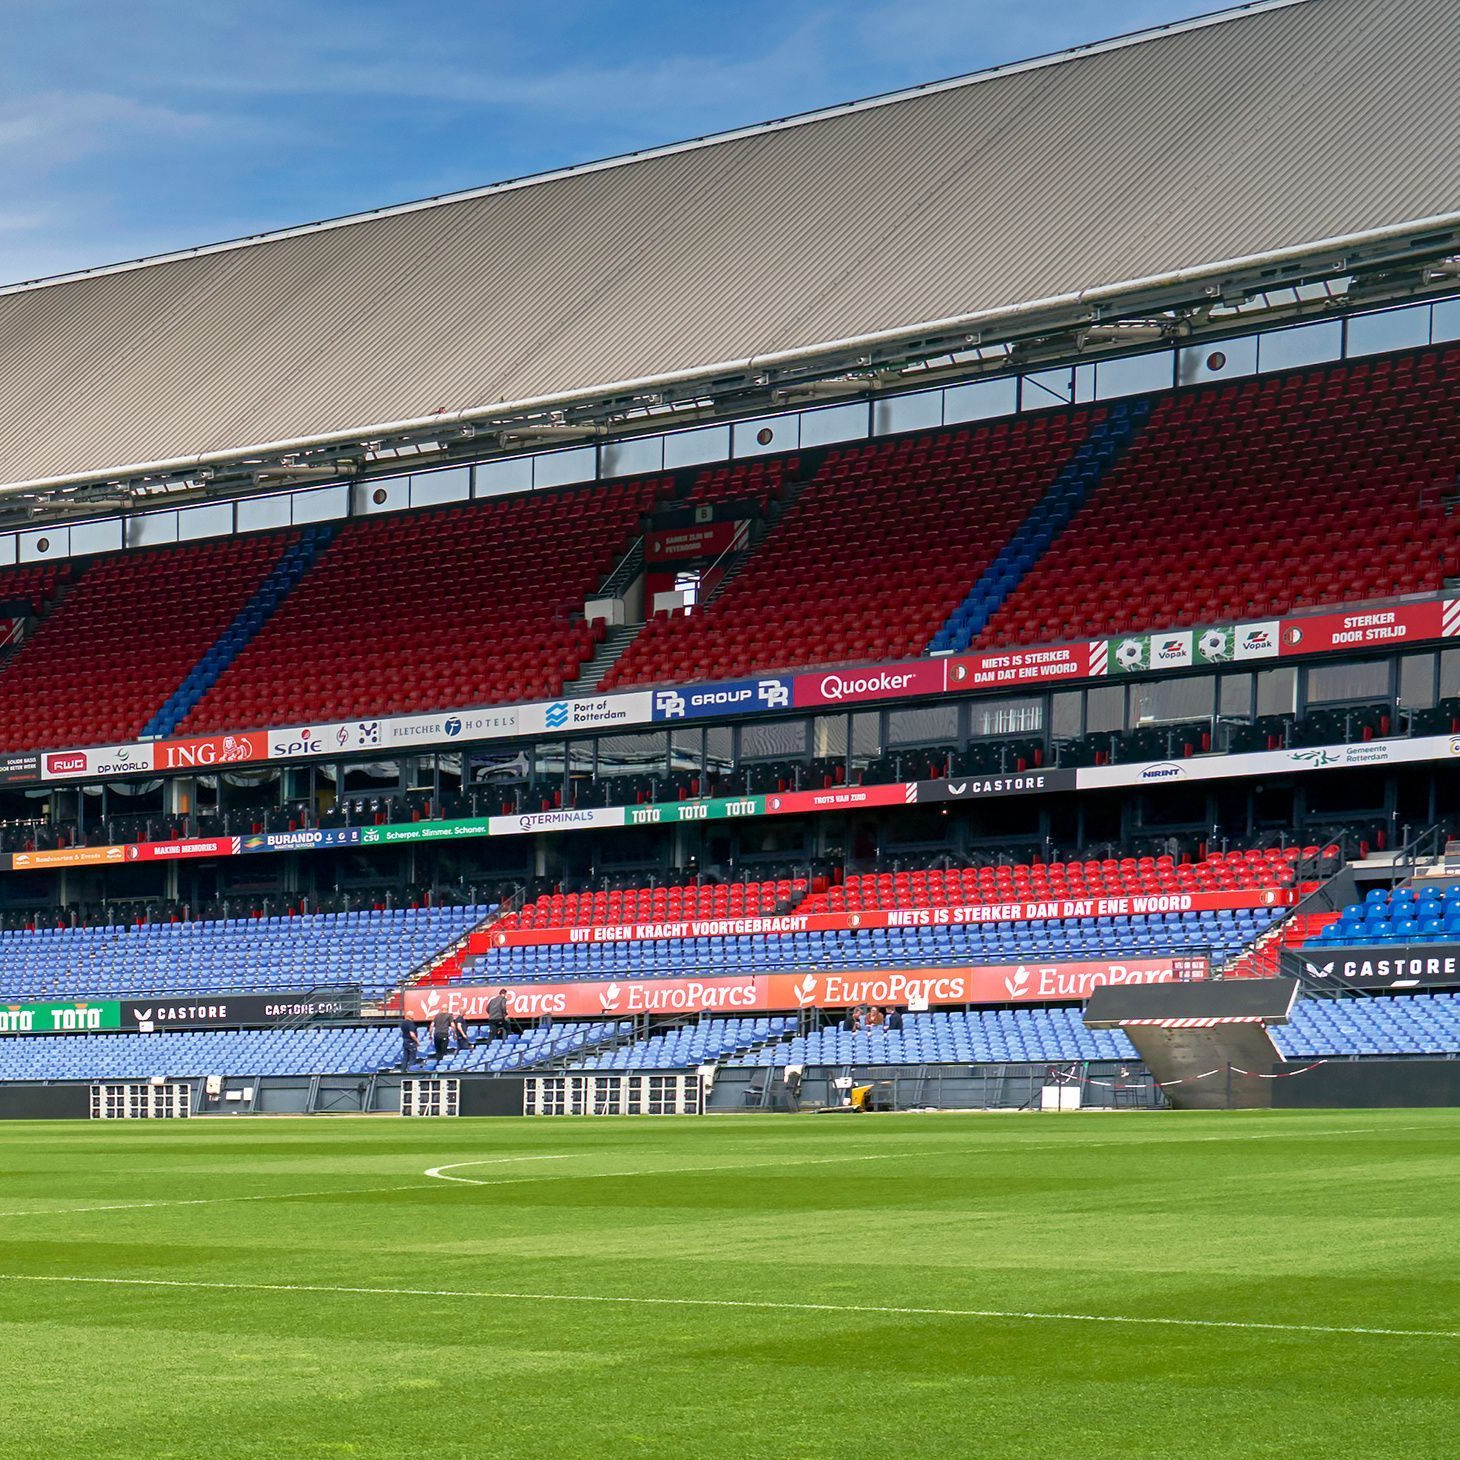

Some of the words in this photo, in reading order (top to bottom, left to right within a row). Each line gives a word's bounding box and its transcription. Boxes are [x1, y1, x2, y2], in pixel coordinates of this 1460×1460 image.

[1344, 612, 1396, 628] STERKER
[1332, 631, 1363, 644] DOOR
[1366, 625, 1407, 640] STRIJD
[1243, 640, 1272, 650] Vopak
[982, 658, 1010, 669] NIETS
[1012, 656, 1023, 665] IS
[1025, 650, 1070, 664] STERKER
[1159, 650, 1187, 660] Vopak
[974, 673, 995, 683] DAN
[997, 671, 1016, 681] DAT
[1019, 668, 1038, 678] ENE
[1040, 663, 1077, 676] WOORD
[821, 673, 912, 699] Quooker
[691, 690, 752, 706] GROUP
[574, 703, 594, 712] Port
[596, 701, 607, 710] of
[574, 710, 626, 722] Rotterdam
[394, 724, 441, 736] FLETCHER
[466, 717, 515, 729] HOTELS
[166, 744, 216, 768] ING
[274, 740, 322, 756] SPIE
[1346, 745, 1386, 755] Gemeente
[54, 756, 84, 770] RWG
[1346, 752, 1389, 763] Rotterdam
[98, 764, 111, 773] DP
[112, 761, 149, 772] WORLD
[1143, 769, 1179, 778] NIRINT
[973, 777, 1045, 793] CASTORE
[814, 796, 834, 804] TROTS
[835, 795, 849, 803] VAN
[851, 793, 866, 801] ZUID
[632, 810, 661, 823] TOTO
[678, 806, 708, 820] TOTO
[725, 802, 756, 816] TOTO
[520, 810, 594, 831] QTERMINALS
[267, 832, 322, 846] BURANDO
[364, 834, 380, 842] CSU
[386, 829, 421, 840] Scherper.
[422, 827, 453, 838] Slimmer.
[454, 826, 486, 836] Schoner.
[154, 845, 181, 855] MAKING
[182, 843, 217, 854] MEMORIES
[887, 911, 930, 926] NIETS
[934, 909, 949, 922] IS
[953, 905, 1022, 922] STERKER
[1026, 903, 1059, 918] DAN
[1063, 900, 1094, 915] DAT
[1098, 898, 1129, 914] ENE
[1133, 895, 1192, 913] WOORD
[570, 929, 590, 942] UIT
[594, 927, 631, 941] EIGEN
[636, 923, 689, 939] KRACHT
[692, 917, 808, 936] VOORTGEBRACHT
[1344, 958, 1455, 977] CASTORE
[824, 974, 965, 1002] EuroParcs
[1037, 965, 1172, 995] EuroParc
[448, 990, 566, 1015] EurParcs
[627, 983, 757, 1010] EuroParcs
[51, 1008, 103, 1030] TOTO
[157, 1005, 227, 1020] CASTORE
